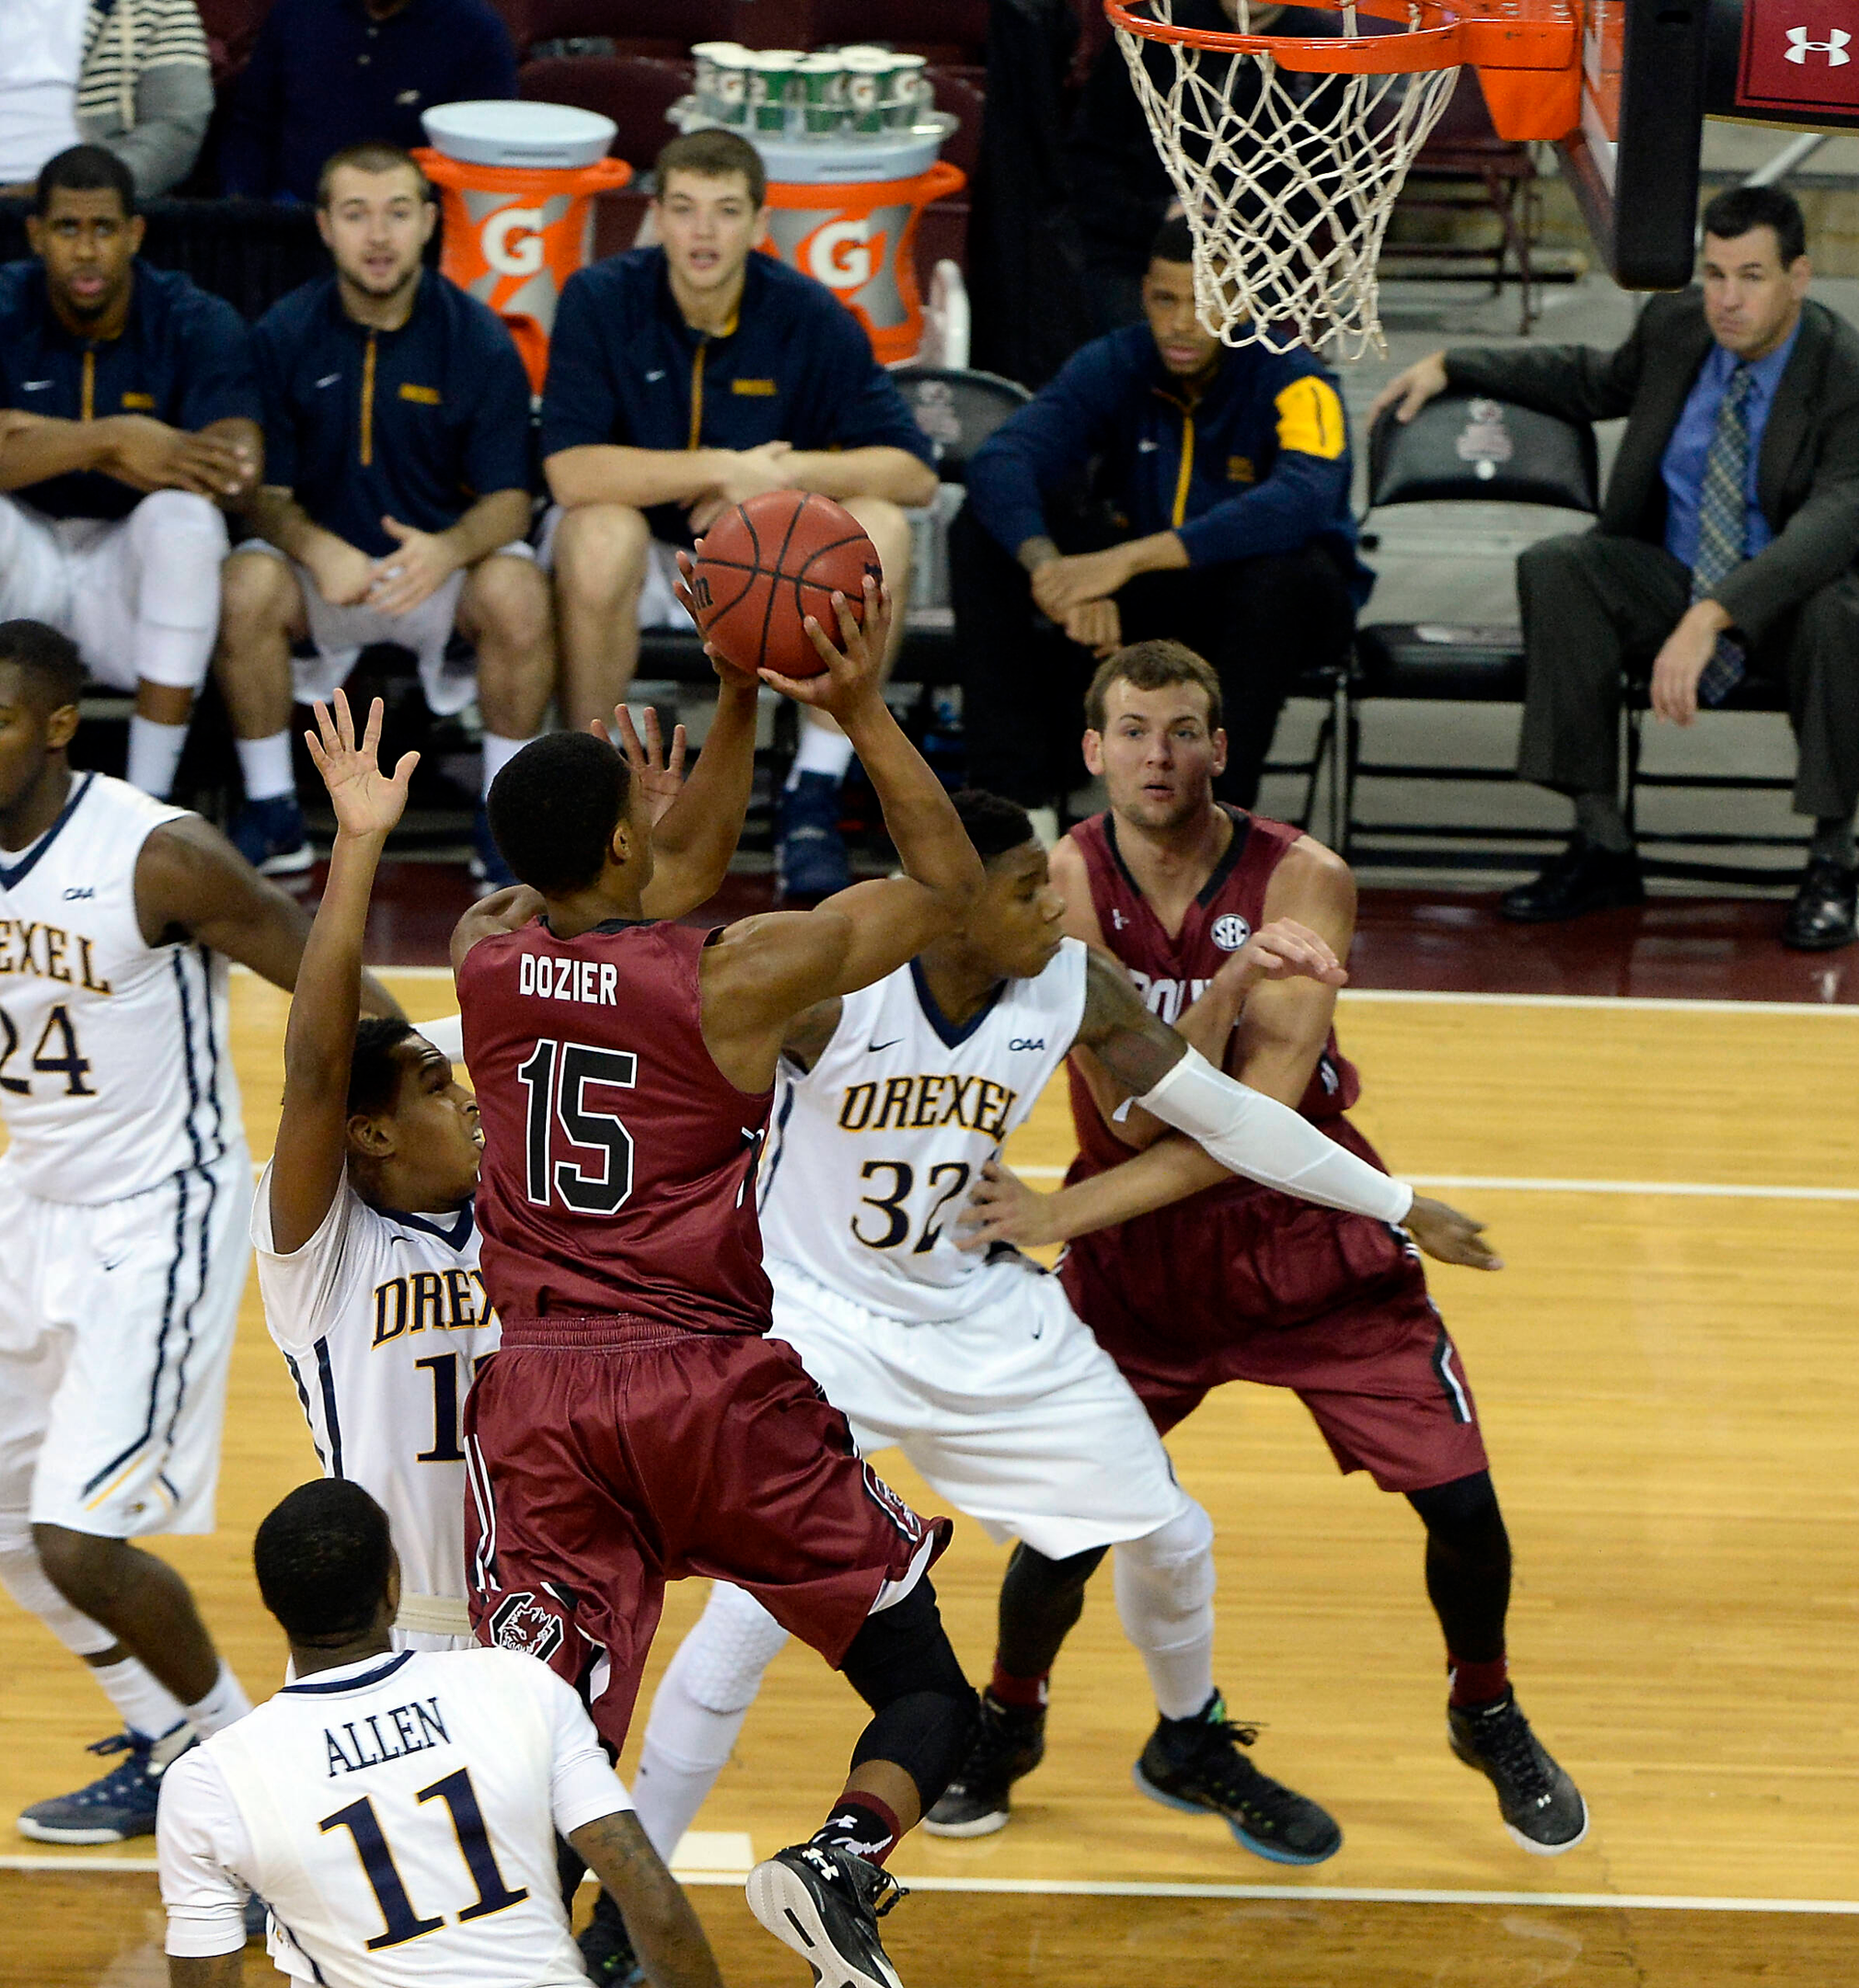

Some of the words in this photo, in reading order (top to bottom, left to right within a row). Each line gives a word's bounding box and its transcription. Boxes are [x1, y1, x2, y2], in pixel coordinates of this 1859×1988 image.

[481, 208, 544, 275] G
[811, 220, 871, 288] G
[1213, 916, 1249, 949] SEC
[519, 953, 618, 1006] DOZIER
[0, 1004, 98, 1095] 24
[1009, 1038, 1045, 1051] CAA
[517, 1037, 638, 1215] 15
[837, 1072, 1017, 1144] DREXEL
[850, 1160, 971, 1254] 32
[414, 1349, 500, 1464] 1
[324, 1696, 451, 1777] ALLEN
[317, 1765, 532, 1953] 11
